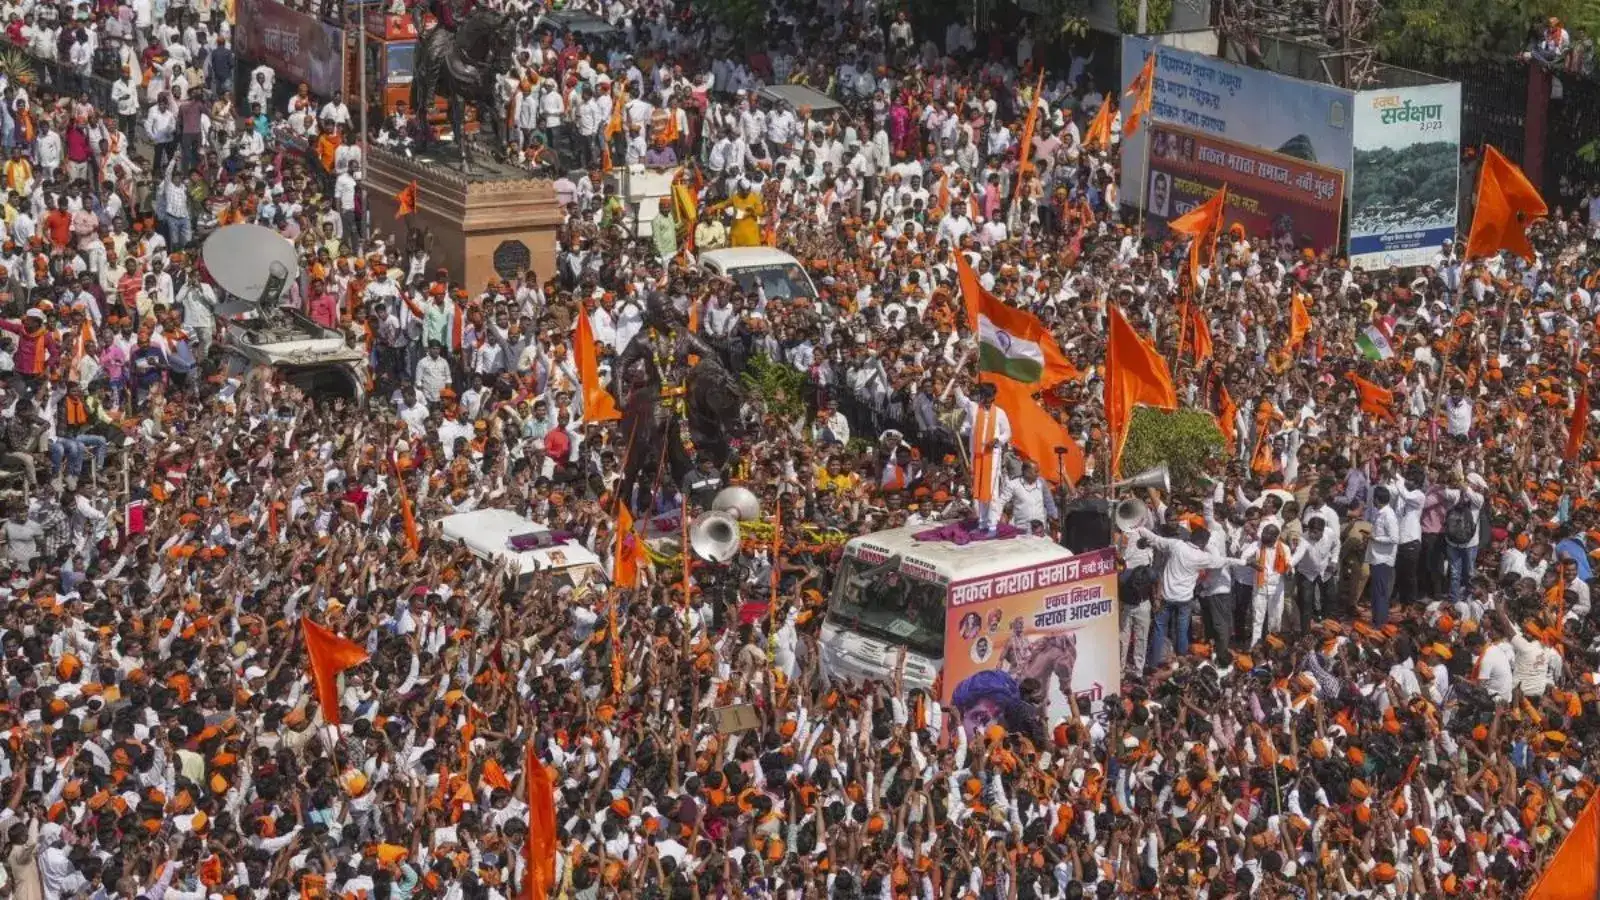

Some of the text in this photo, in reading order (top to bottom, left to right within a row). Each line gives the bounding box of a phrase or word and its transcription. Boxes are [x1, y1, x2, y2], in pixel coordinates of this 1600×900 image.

[1380, 99, 1443, 124] सर्वेक्षण
[1199, 146, 1226, 168] सकल
[1228, 153, 1256, 175] मराठा
[860, 542, 891, 554] GOODS
[951, 577, 992, 606] सकल
[995, 569, 1034, 595] मराठा
[1037, 559, 1081, 586] समाज
[1044, 585, 1101, 609] एकच मिशन
[1034, 599, 1113, 628] मराठा आरक्षण
